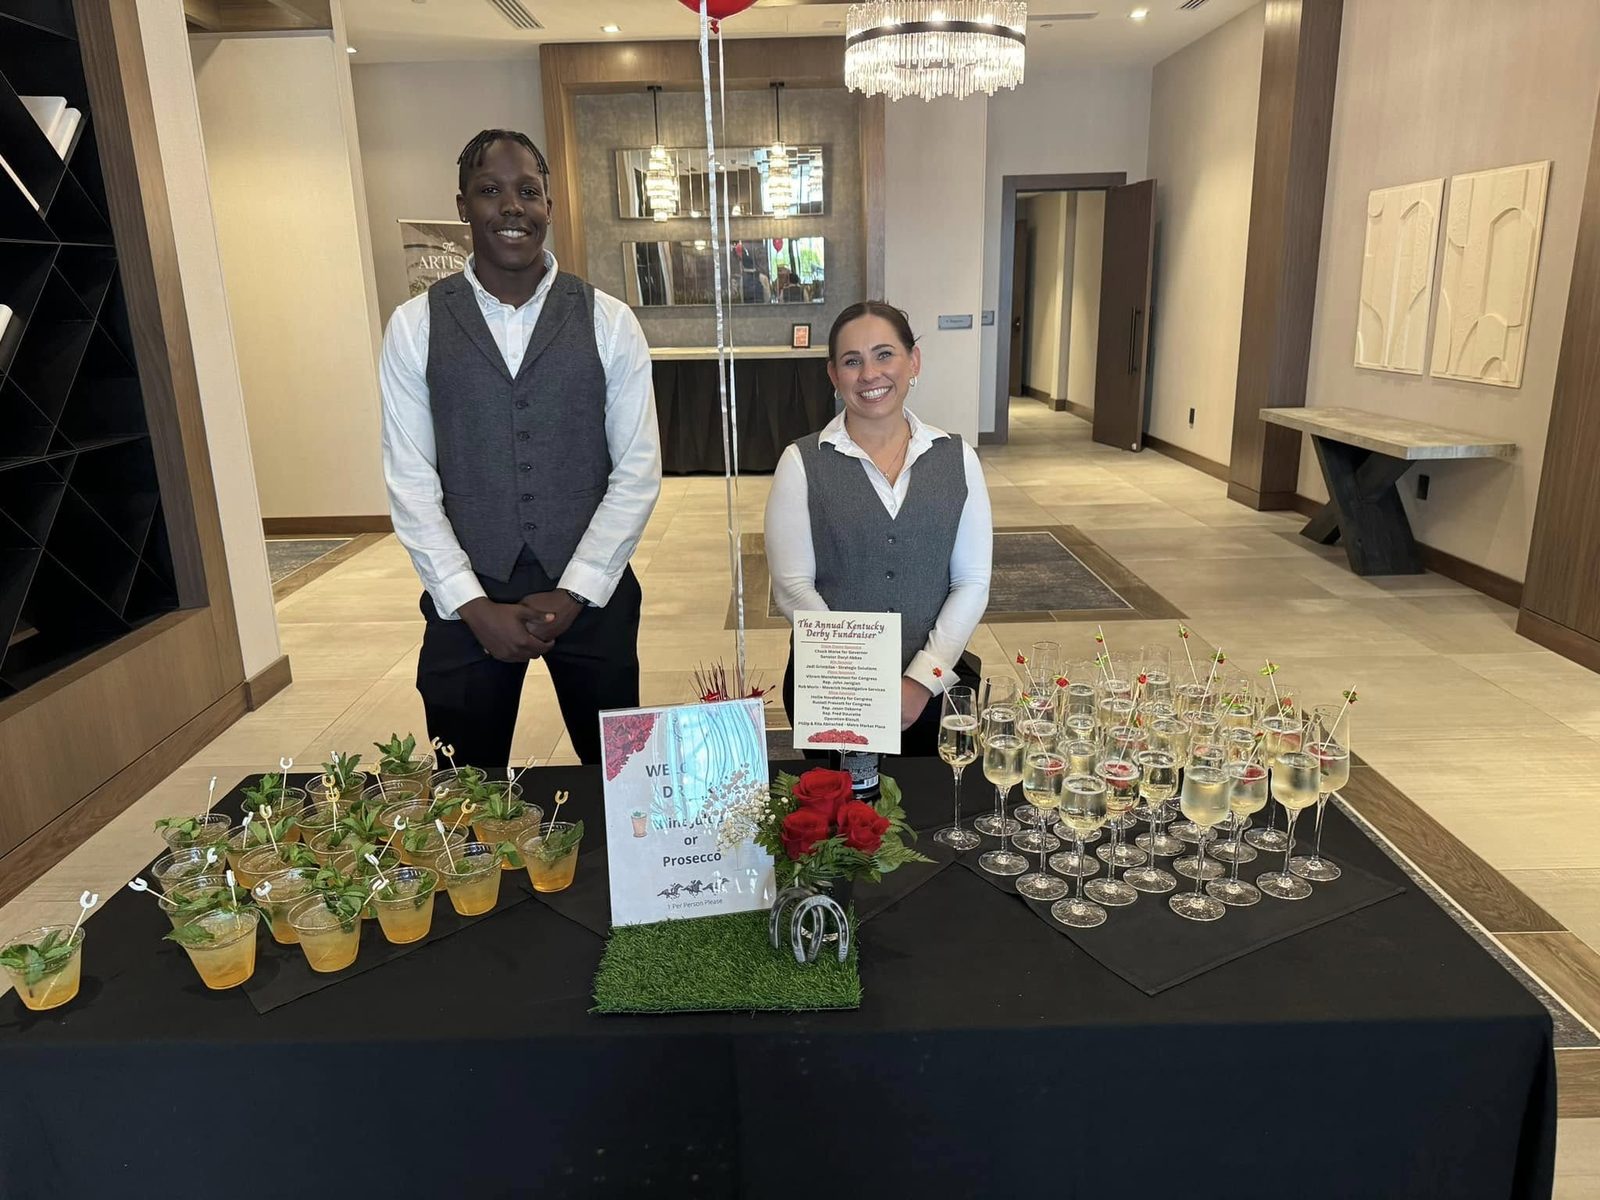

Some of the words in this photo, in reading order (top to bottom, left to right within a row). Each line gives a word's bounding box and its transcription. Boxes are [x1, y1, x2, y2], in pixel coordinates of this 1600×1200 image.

[442, 242, 457, 253] The
[418, 256, 465, 270] ARTIS
[798, 618, 812, 628] The
[814, 620, 844, 629] Annual
[846, 620, 884, 634] Kentucky
[806, 629, 830, 640] Derby
[832, 630, 877, 639] Fundraiser
[684, 836, 698, 846] or
[663, 851, 722, 868] Prosecco
